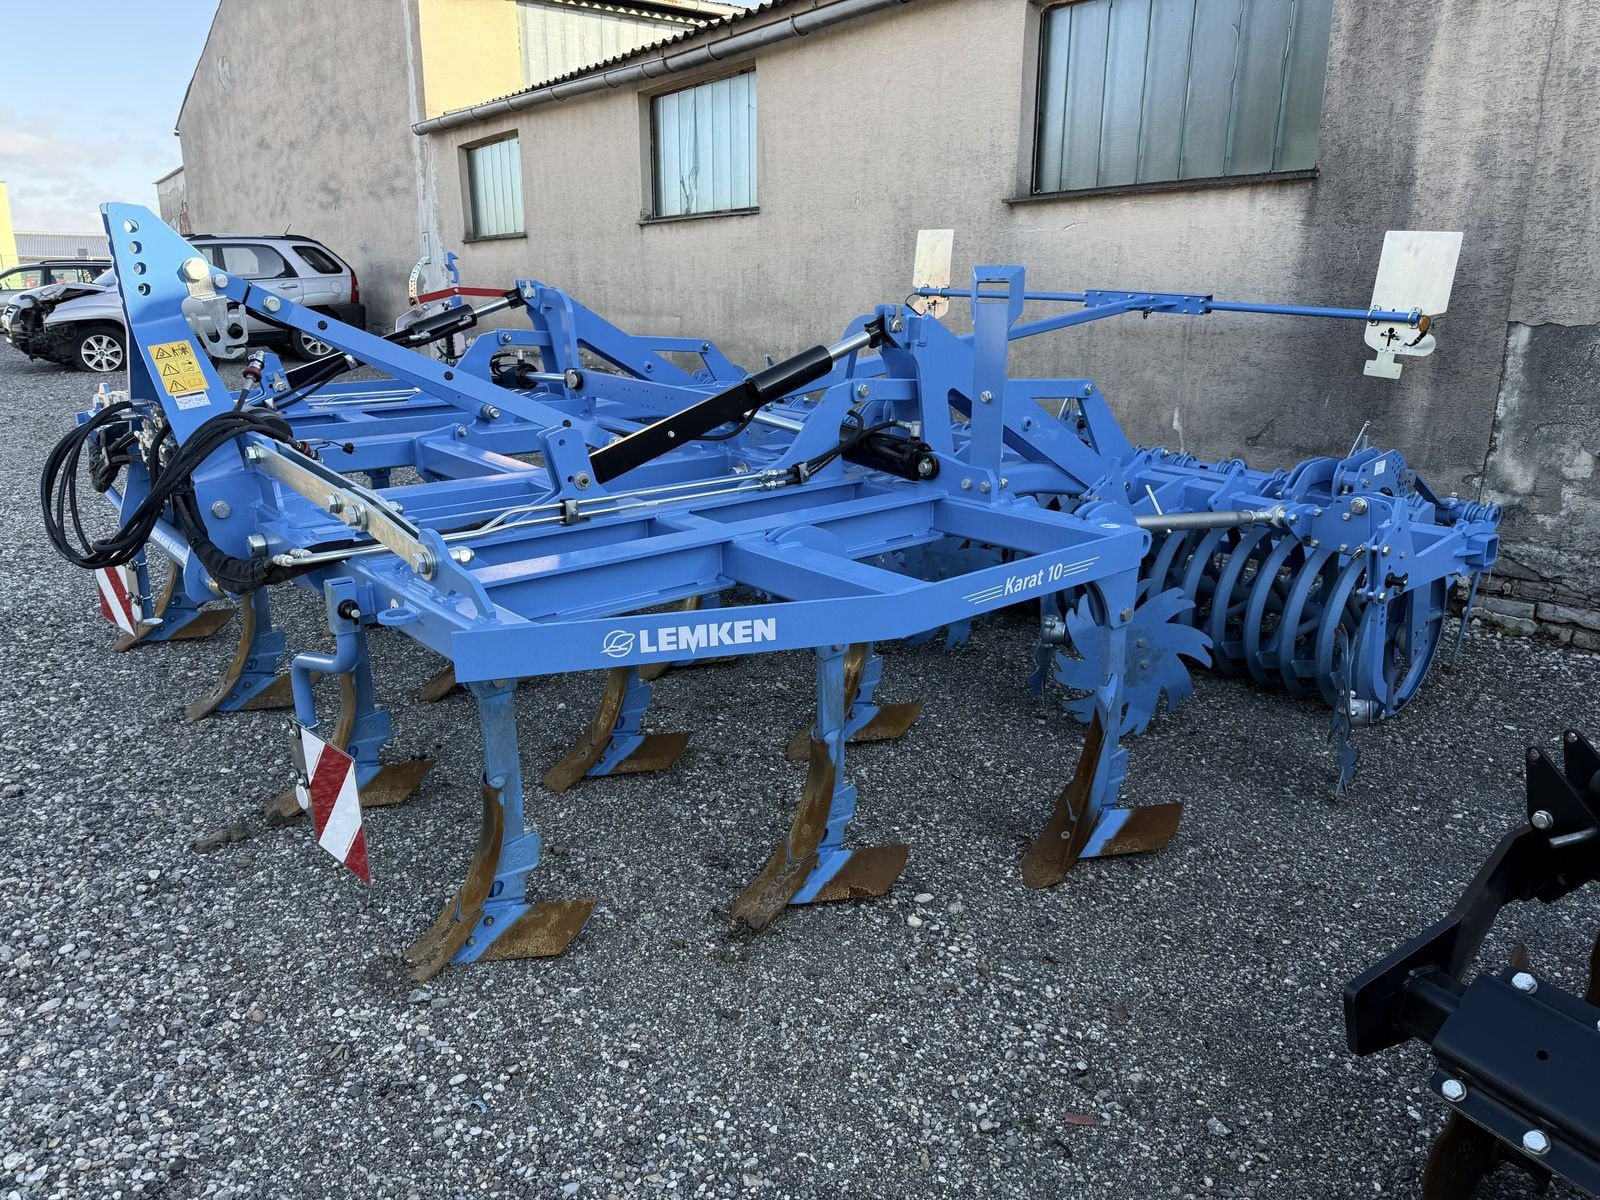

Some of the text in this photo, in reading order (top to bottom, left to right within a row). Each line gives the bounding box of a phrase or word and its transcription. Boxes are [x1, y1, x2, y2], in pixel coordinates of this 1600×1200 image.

[1004, 562, 1063, 596] Karat 10
[640, 617, 776, 655] LEMKEN
